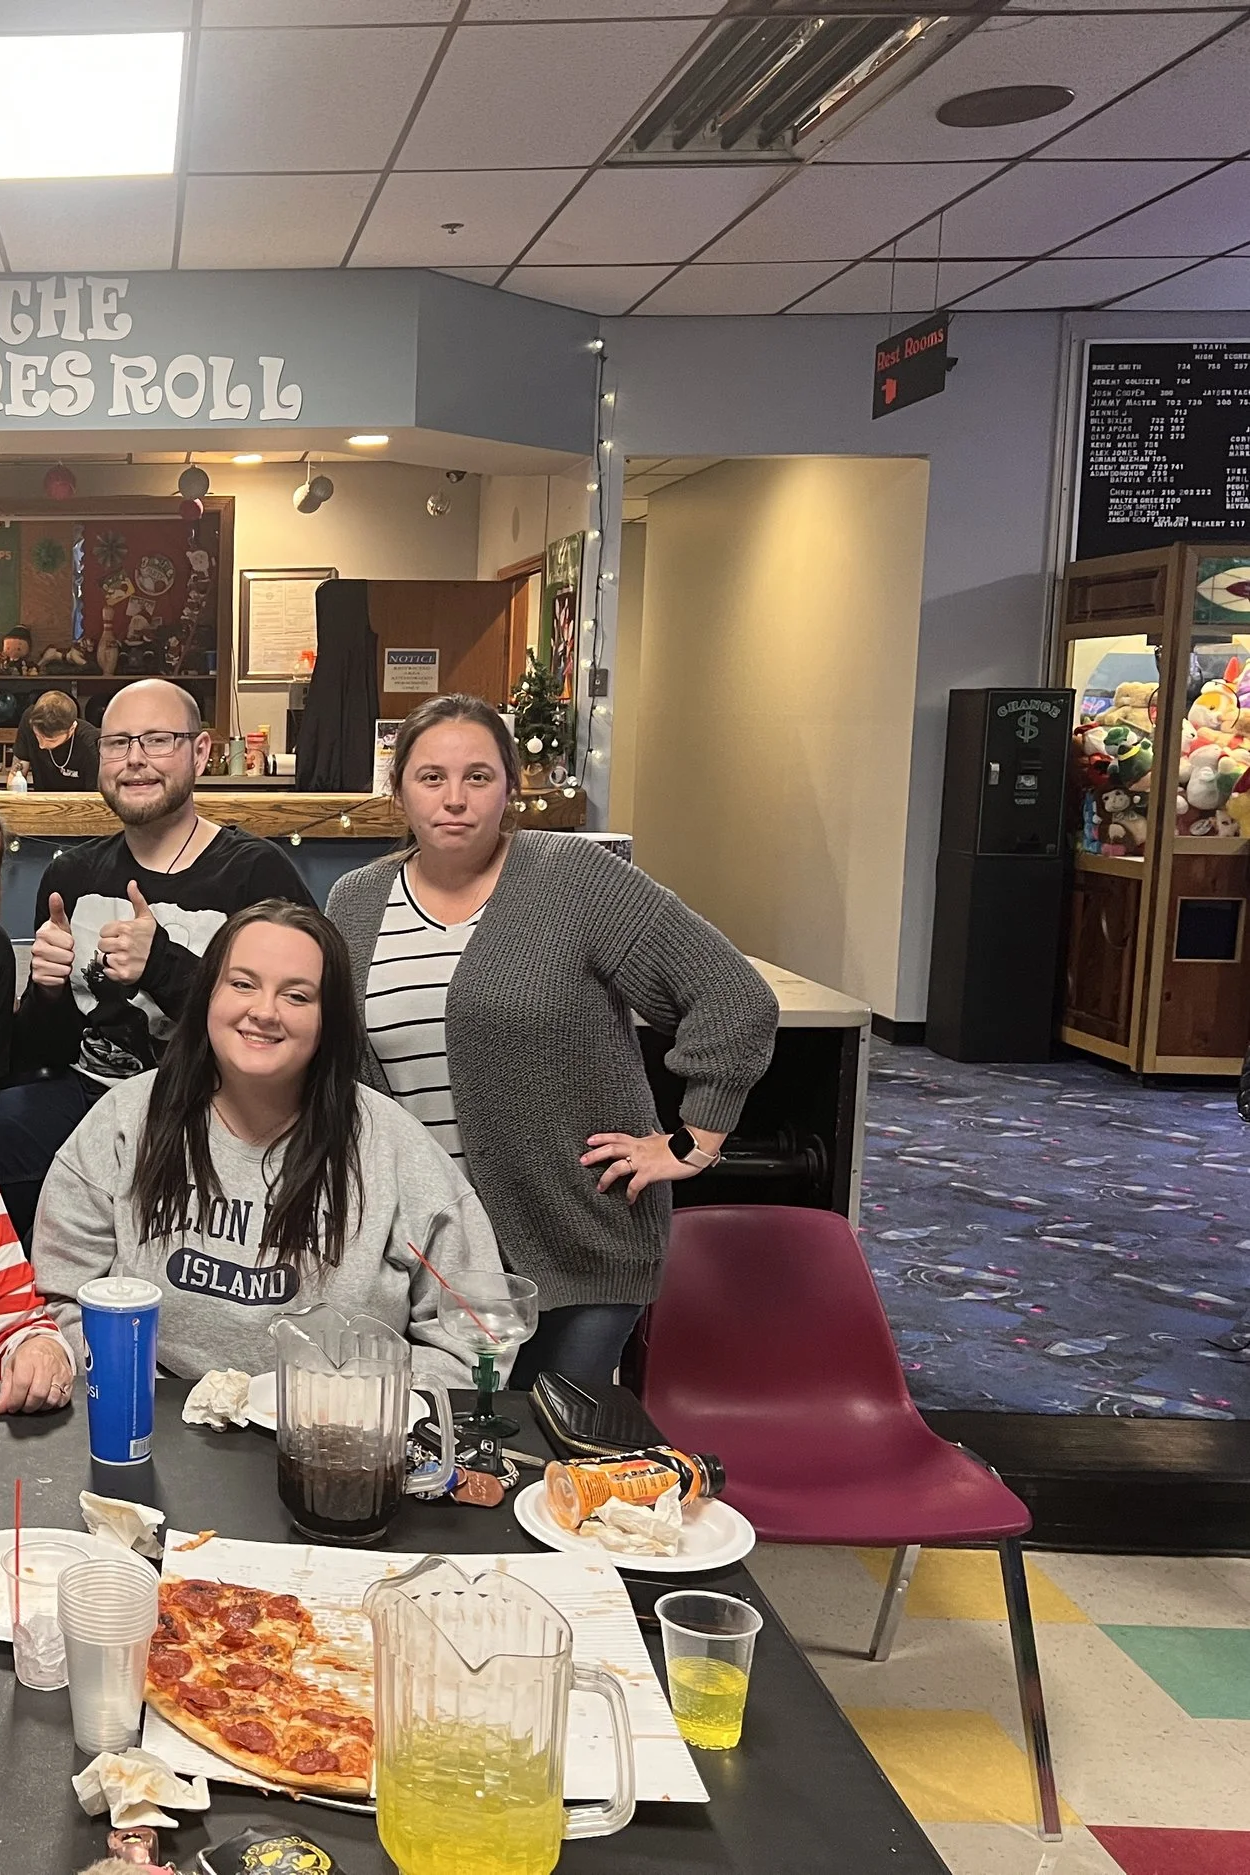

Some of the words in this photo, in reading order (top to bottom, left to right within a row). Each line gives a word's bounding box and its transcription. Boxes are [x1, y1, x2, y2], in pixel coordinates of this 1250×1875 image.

[877, 345, 900, 372] Rest
[904, 328, 944, 359] Rooms
[108, 353, 303, 421] ROLL
[1226, 475, 1250, 483] APRIL
[997, 699, 1061, 719] CHANGE
[179, 1254, 286, 1300] ISLAND
